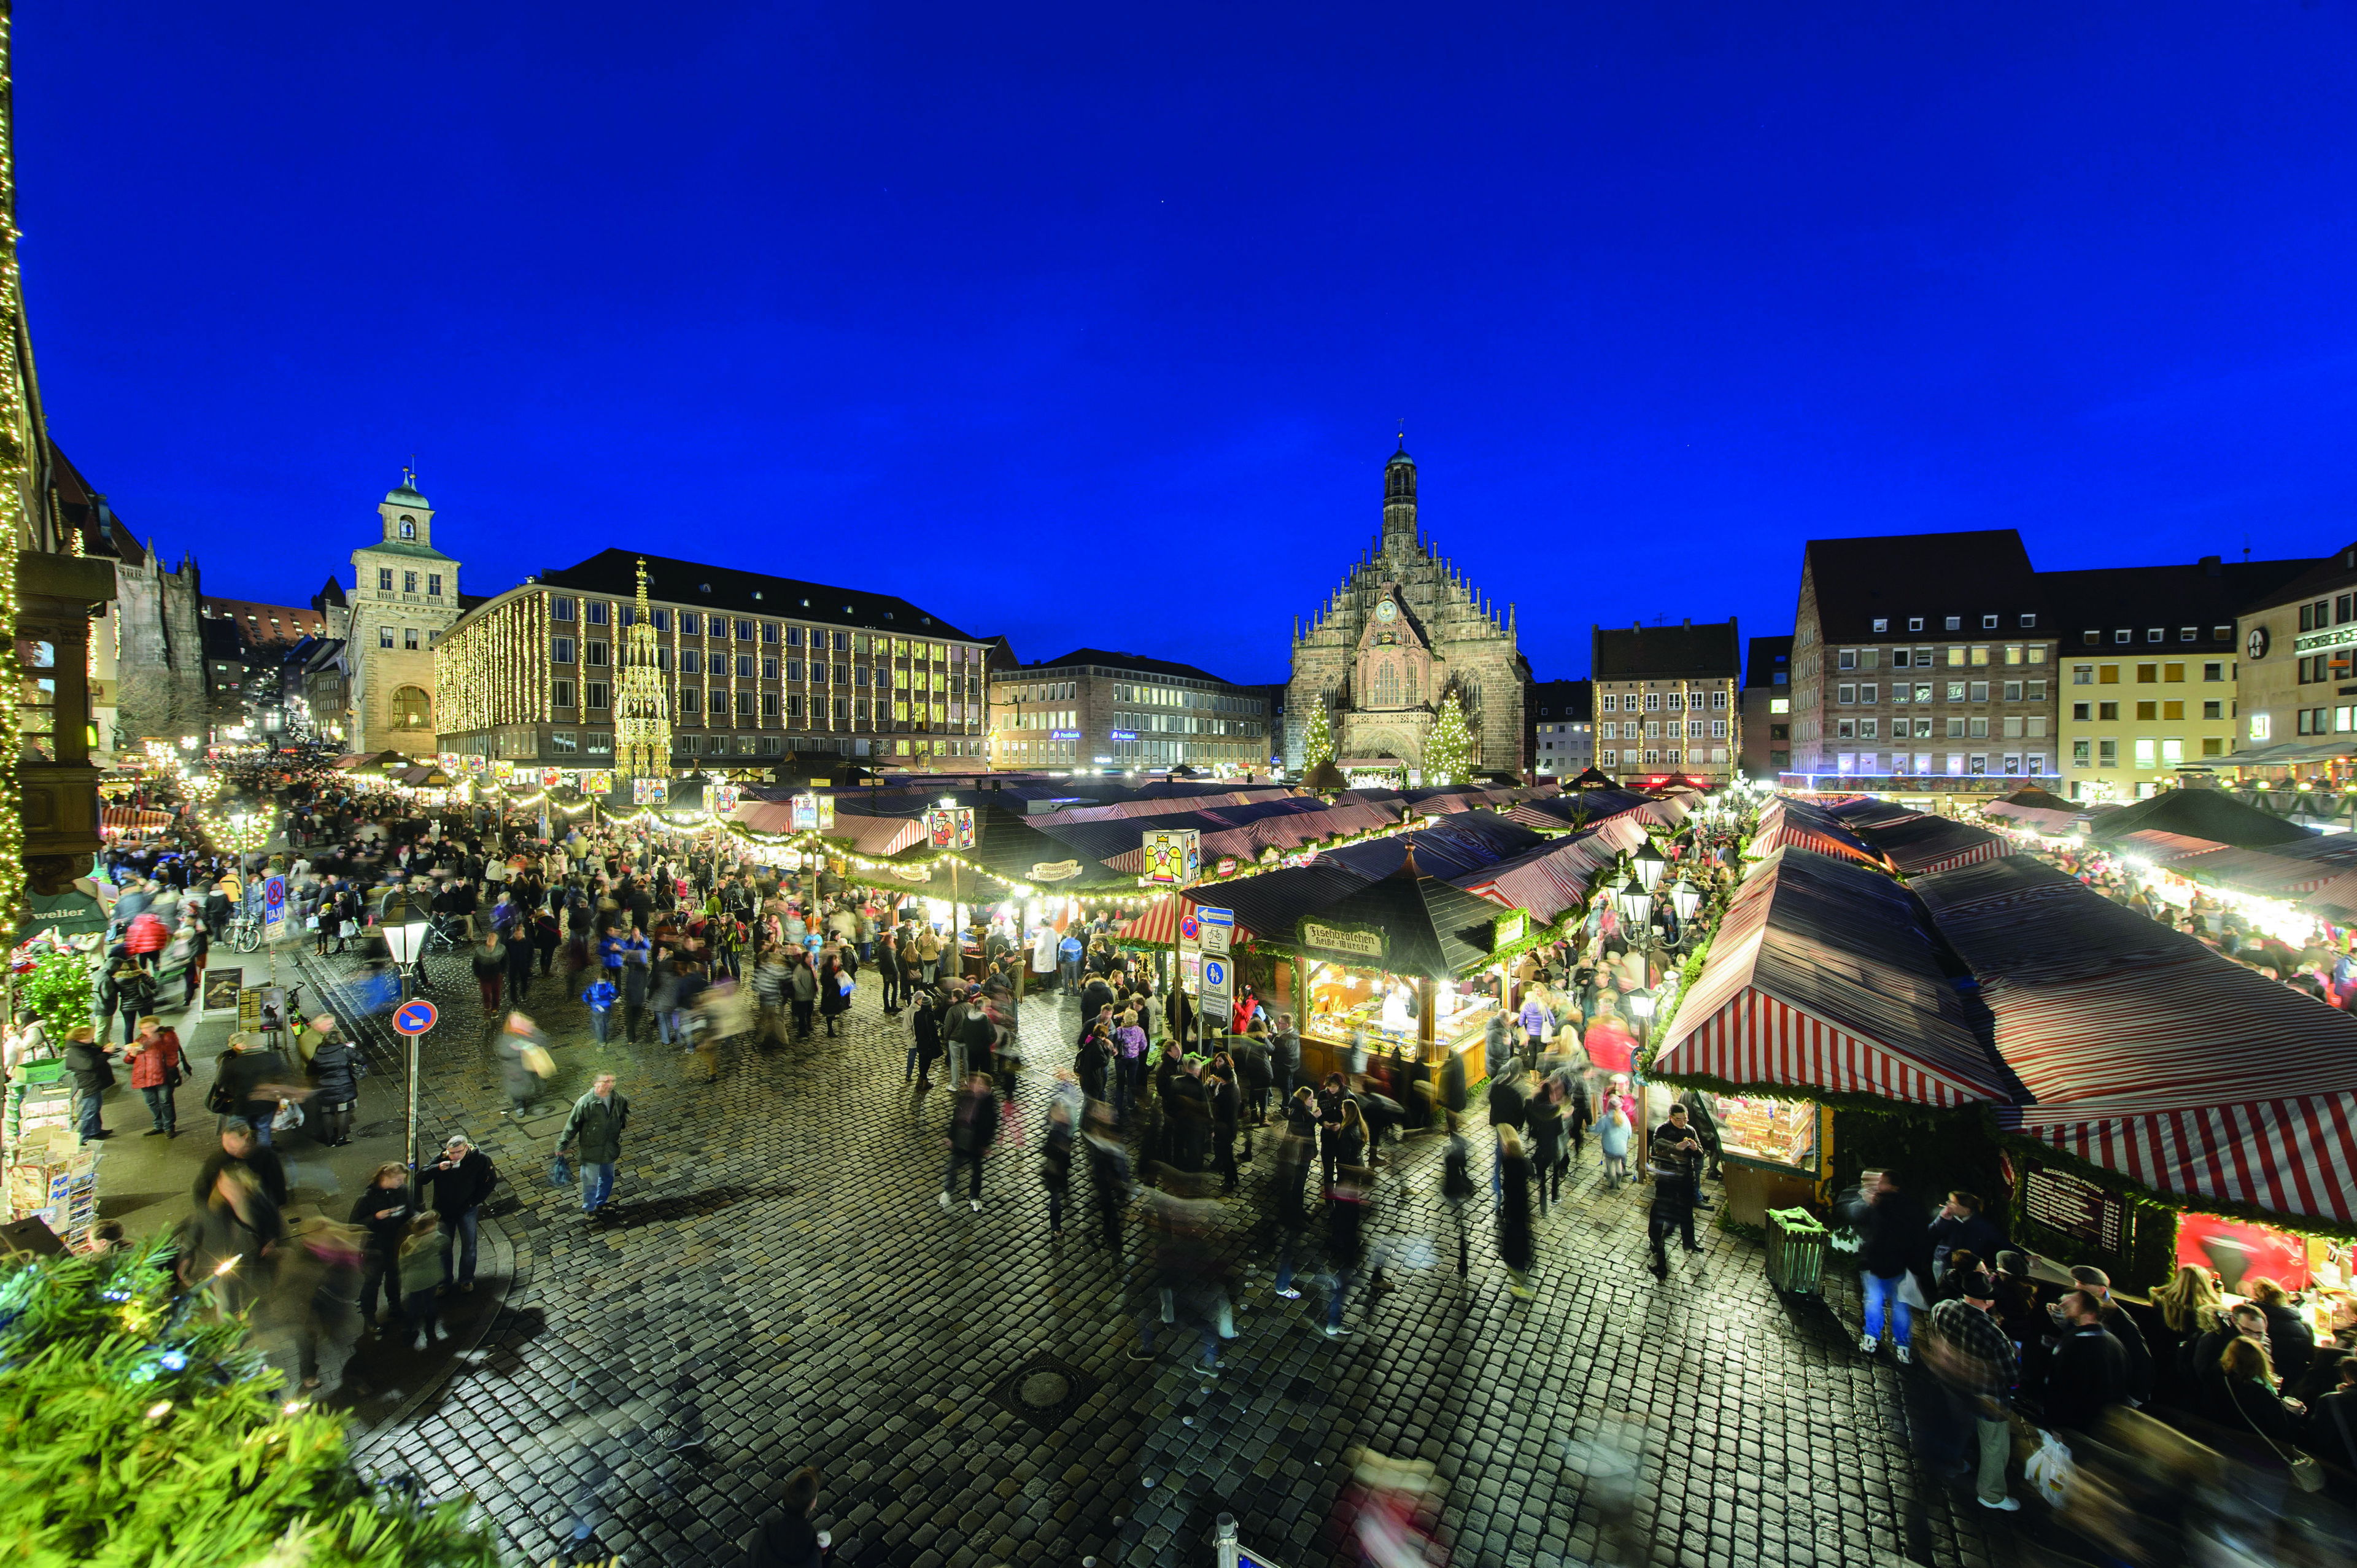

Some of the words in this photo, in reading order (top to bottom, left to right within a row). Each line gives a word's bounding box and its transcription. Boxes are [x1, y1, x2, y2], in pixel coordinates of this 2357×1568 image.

[32, 909, 86, 919] welier
[267, 906, 284, 921] TAXI
[1309, 925, 1375, 944] Fischbrötchen
[28, 1069, 55, 1078] PONS
